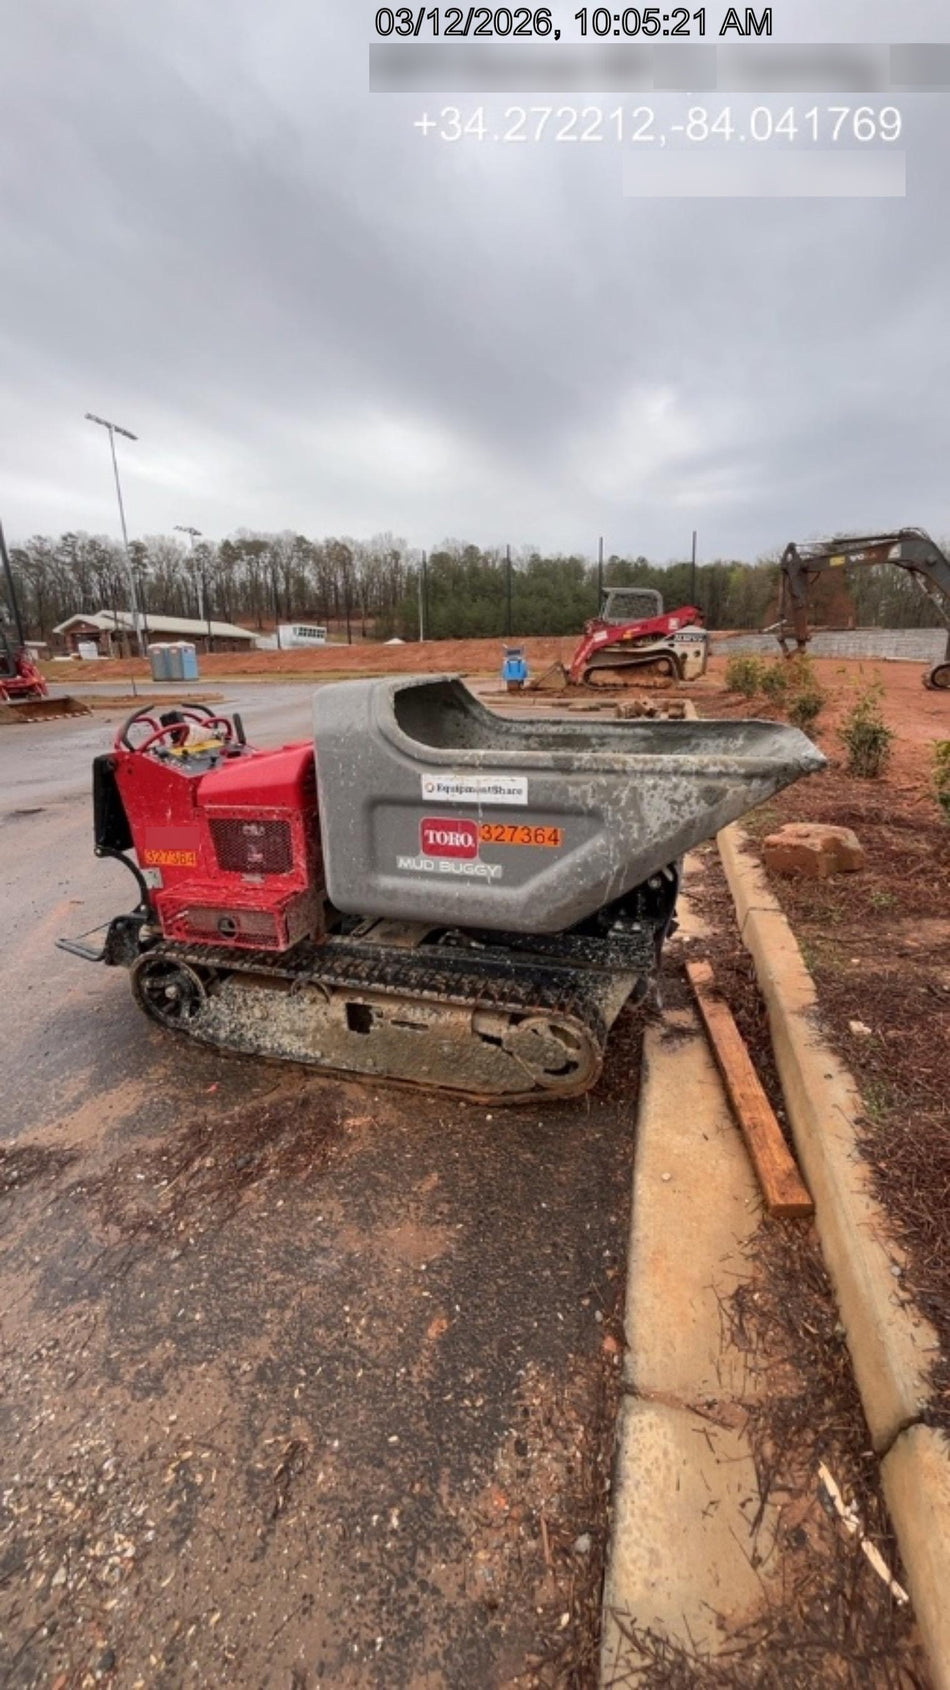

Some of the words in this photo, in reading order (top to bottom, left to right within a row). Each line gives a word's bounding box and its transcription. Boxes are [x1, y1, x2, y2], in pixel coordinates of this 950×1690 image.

[424, 829, 474, 847] TORO
[481, 824, 560, 846] 327364
[398, 858, 434, 871] MUD
[439, 861, 500, 877] BUGGY
